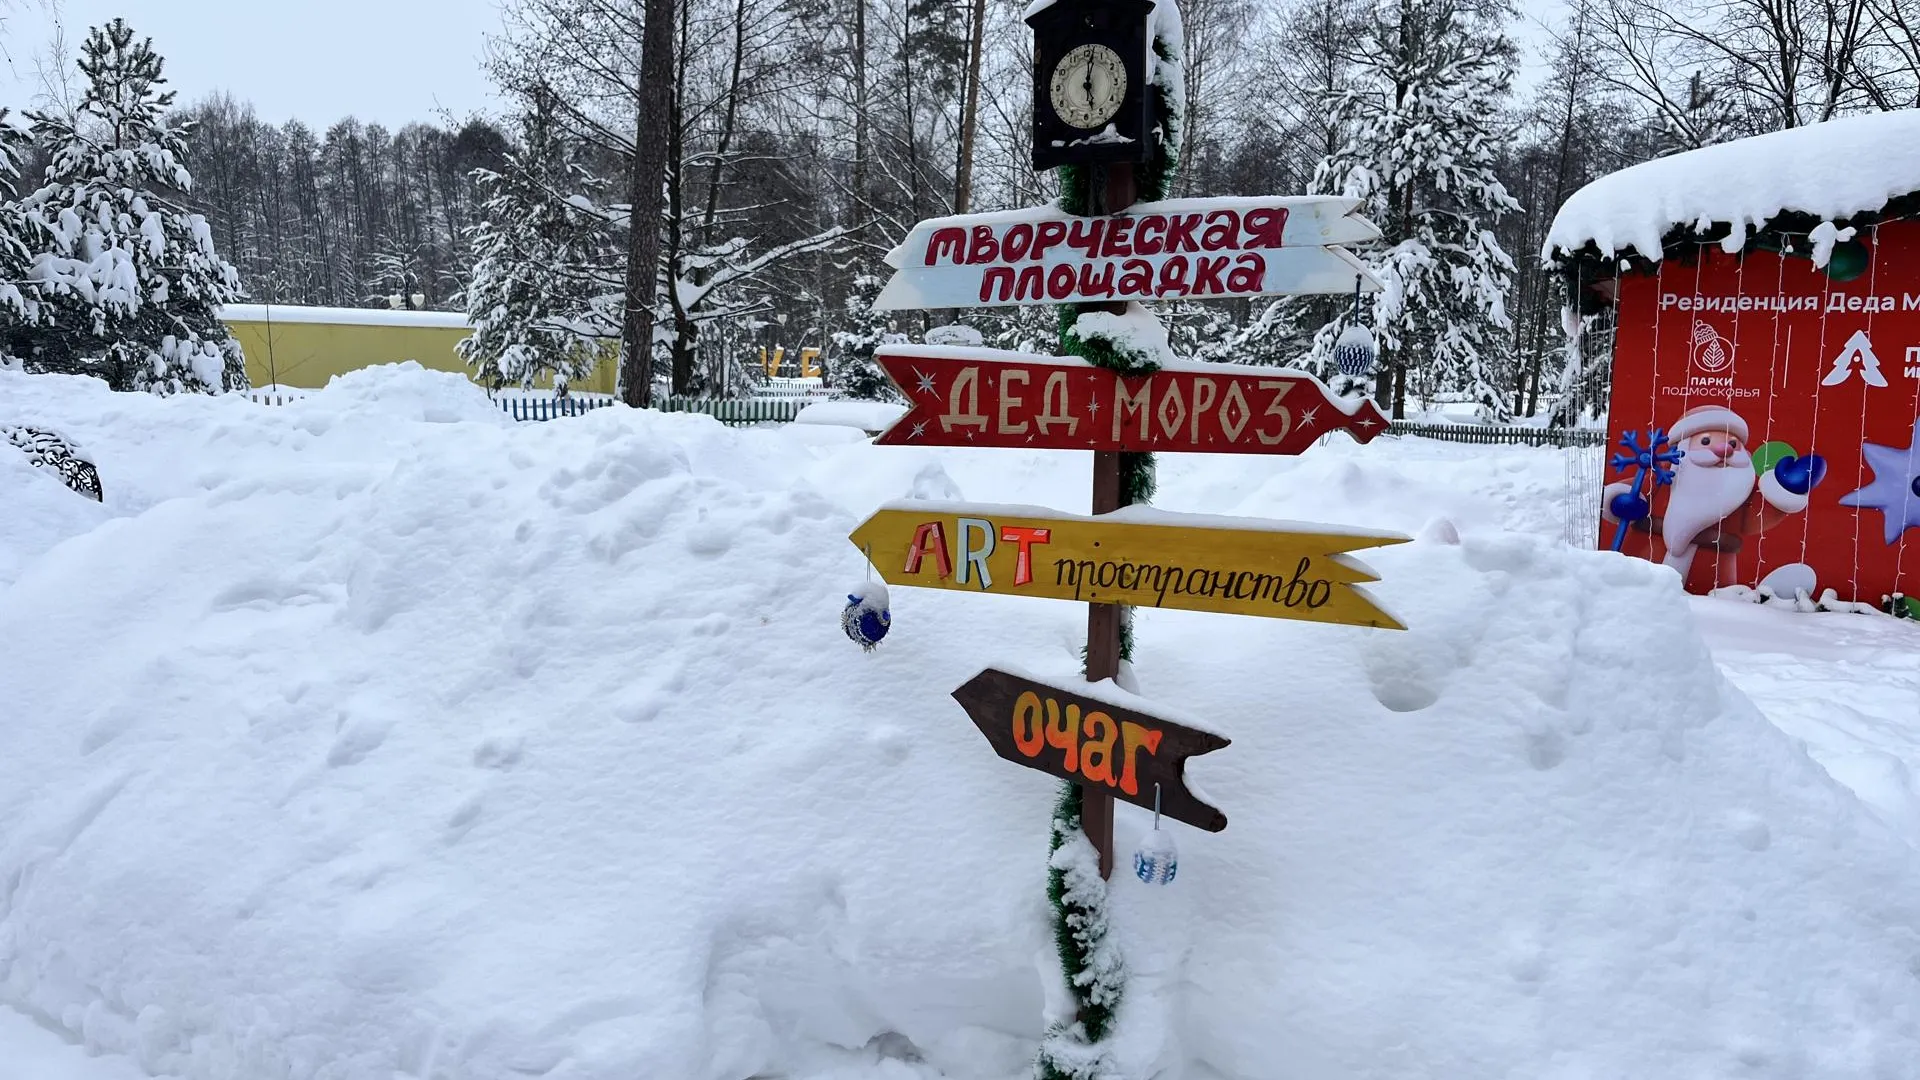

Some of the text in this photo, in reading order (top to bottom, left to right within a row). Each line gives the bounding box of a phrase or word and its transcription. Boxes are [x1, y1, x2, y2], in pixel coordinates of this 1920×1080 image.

[1661, 293, 1819, 313] Резиденция
[1826, 292, 1896, 313] Деда
[1662, 386, 1760, 398] ПОДМОСКОВЬЯ
[1690, 376, 1733, 387] ПАРКИ
[939, 366, 1298, 446] ДЕД МОРОЗ
[903, 517, 1331, 609] ART пространство
